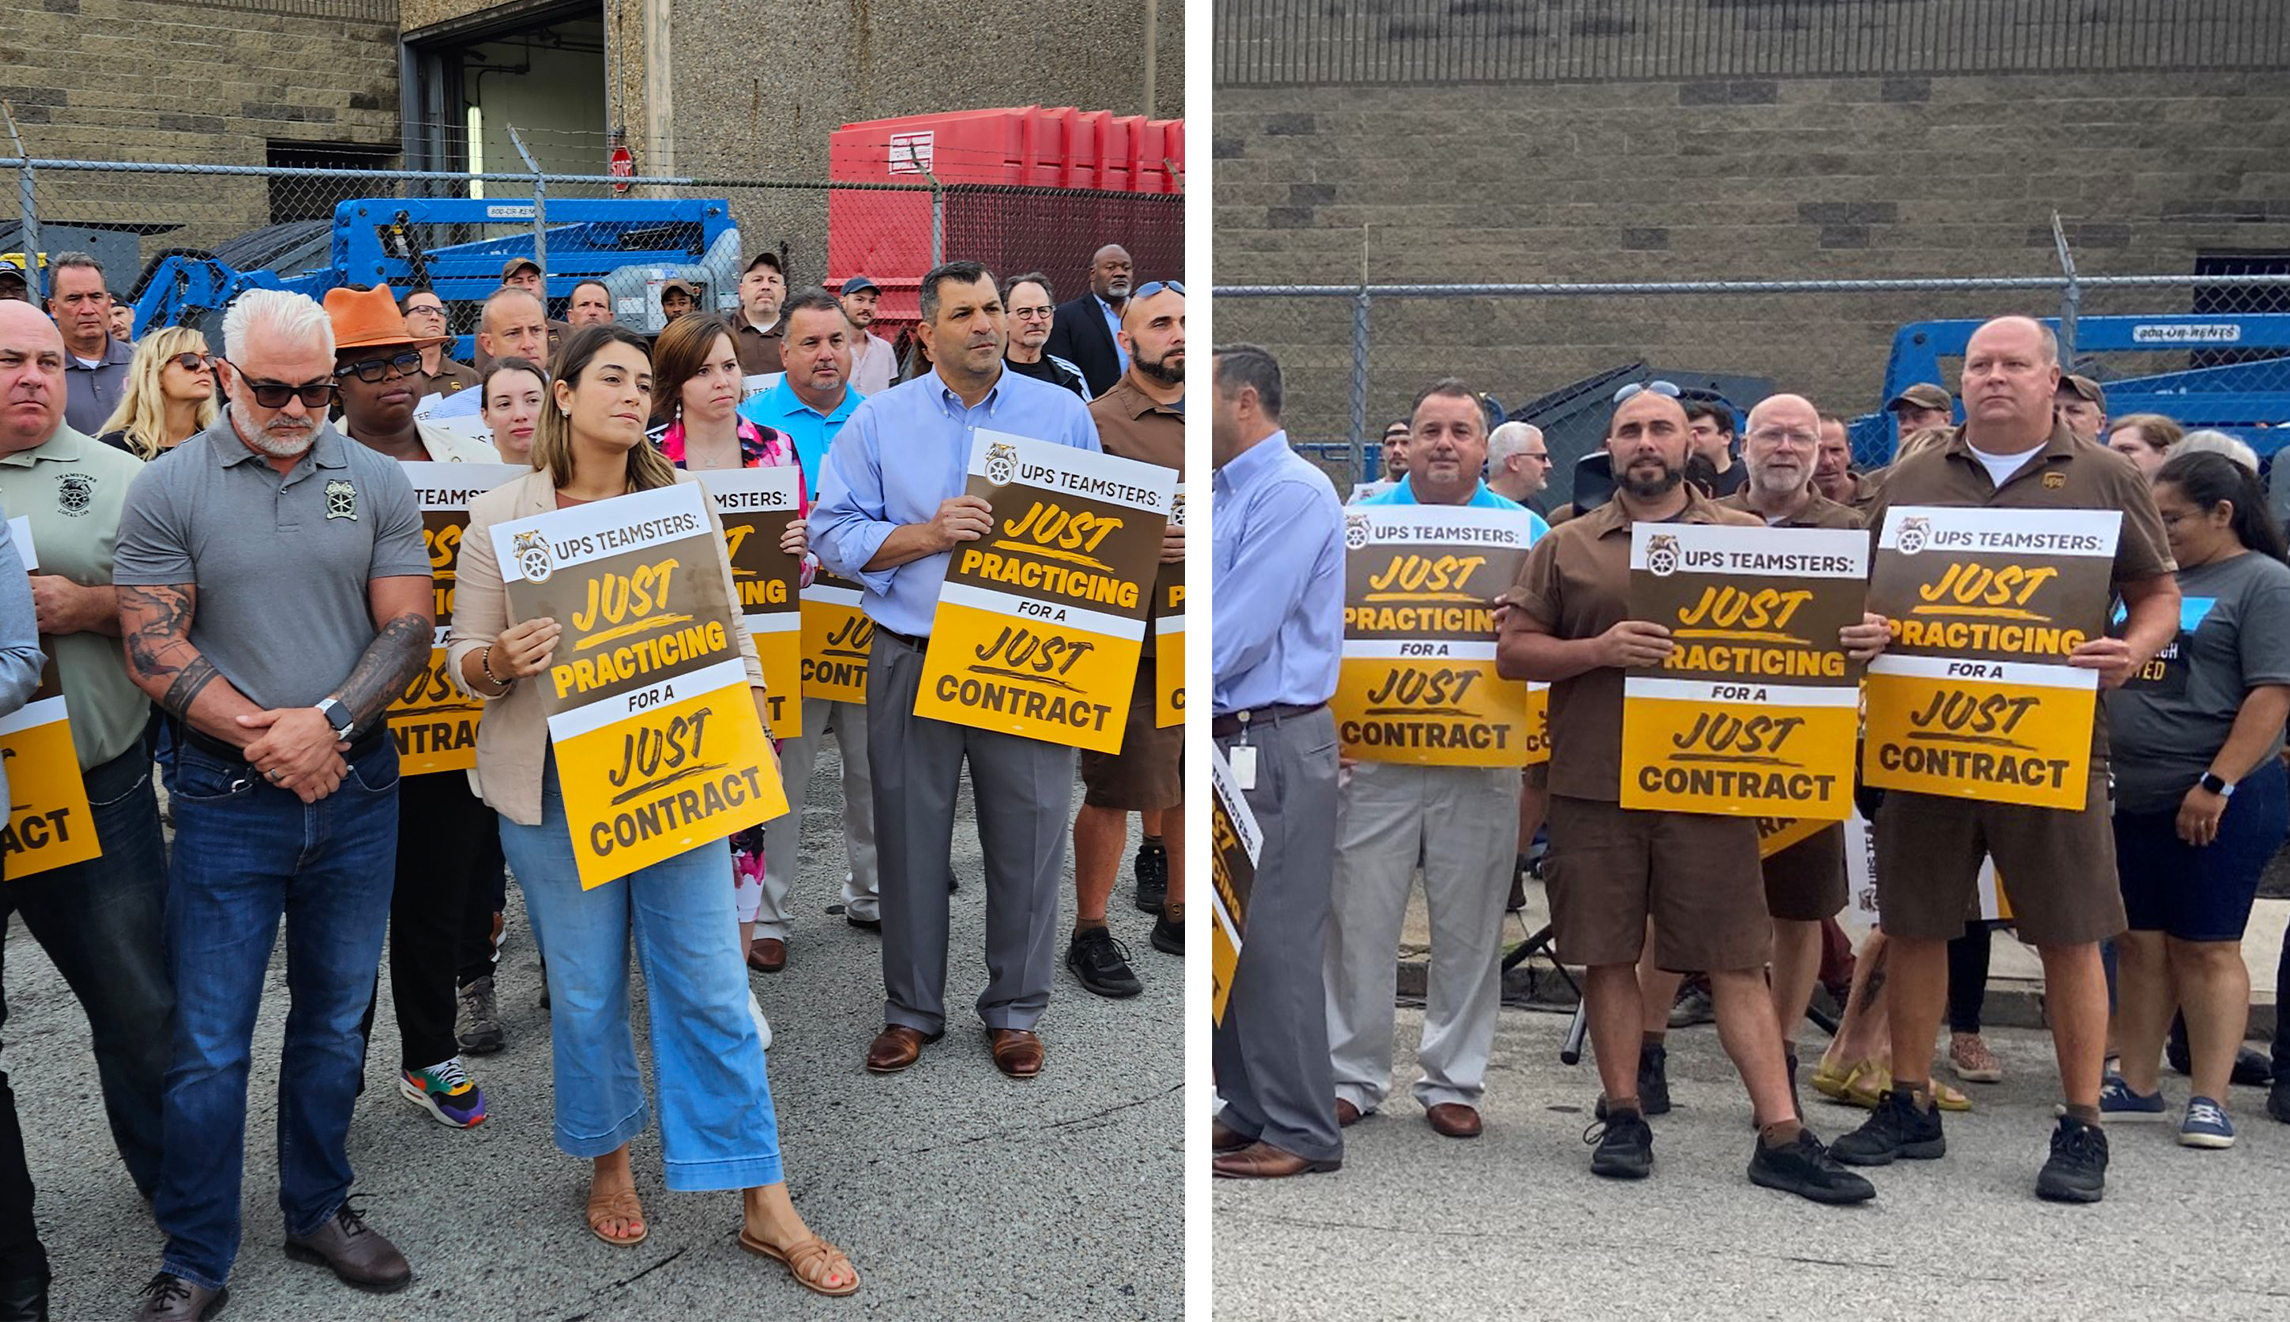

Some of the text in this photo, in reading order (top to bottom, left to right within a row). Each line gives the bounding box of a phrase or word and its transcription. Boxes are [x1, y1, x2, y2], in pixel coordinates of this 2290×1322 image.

[55, 473, 97, 483] TEAMSTERS
[1021, 463, 1161, 507] UPS TEAMSTERS:
[555, 536, 594, 560] UPS
[596, 513, 700, 552] TEAMSTERS:
[1003, 501, 1124, 553] JUST
[1375, 526, 1519, 544] UPS TEAMSTERS:
[1934, 531, 2103, 551] UPS TEAMSTERS:
[960, 549, 1140, 609] PRACTICING
[1370, 555, 1486, 591] JUST
[1685, 551, 1855, 572] UPS TEAMSTERS:
[572, 558, 679, 631] JUST
[1920, 563, 2058, 606] JUST
[1018, 601, 1066, 622] FOR A
[1344, 607, 1496, 632] PRACTICIN
[1679, 586, 1813, 629] JUST
[550, 621, 728, 699] PRACTICING
[975, 626, 1095, 676] JUST
[1400, 643, 1449, 656] FOR A
[1664, 644, 1845, 677] RACTICING
[1367, 668, 1483, 705] JUST
[1947, 662, 2004, 679] FOR A
[628, 685, 675, 712] FOR A
[936, 675, 1112, 732] CONTRACT
[1711, 685, 1767, 701] FOR A
[1911, 690, 2041, 734] JUST
[609, 707, 713, 788] JUST
[1340, 721, 1511, 750] CONTRACT
[1673, 712, 1805, 753] JUST
[1638, 766, 1836, 801] CONTRACT
[1880, 743, 2069, 789] CONTRACT
[590, 766, 762, 857] CONTRACT
